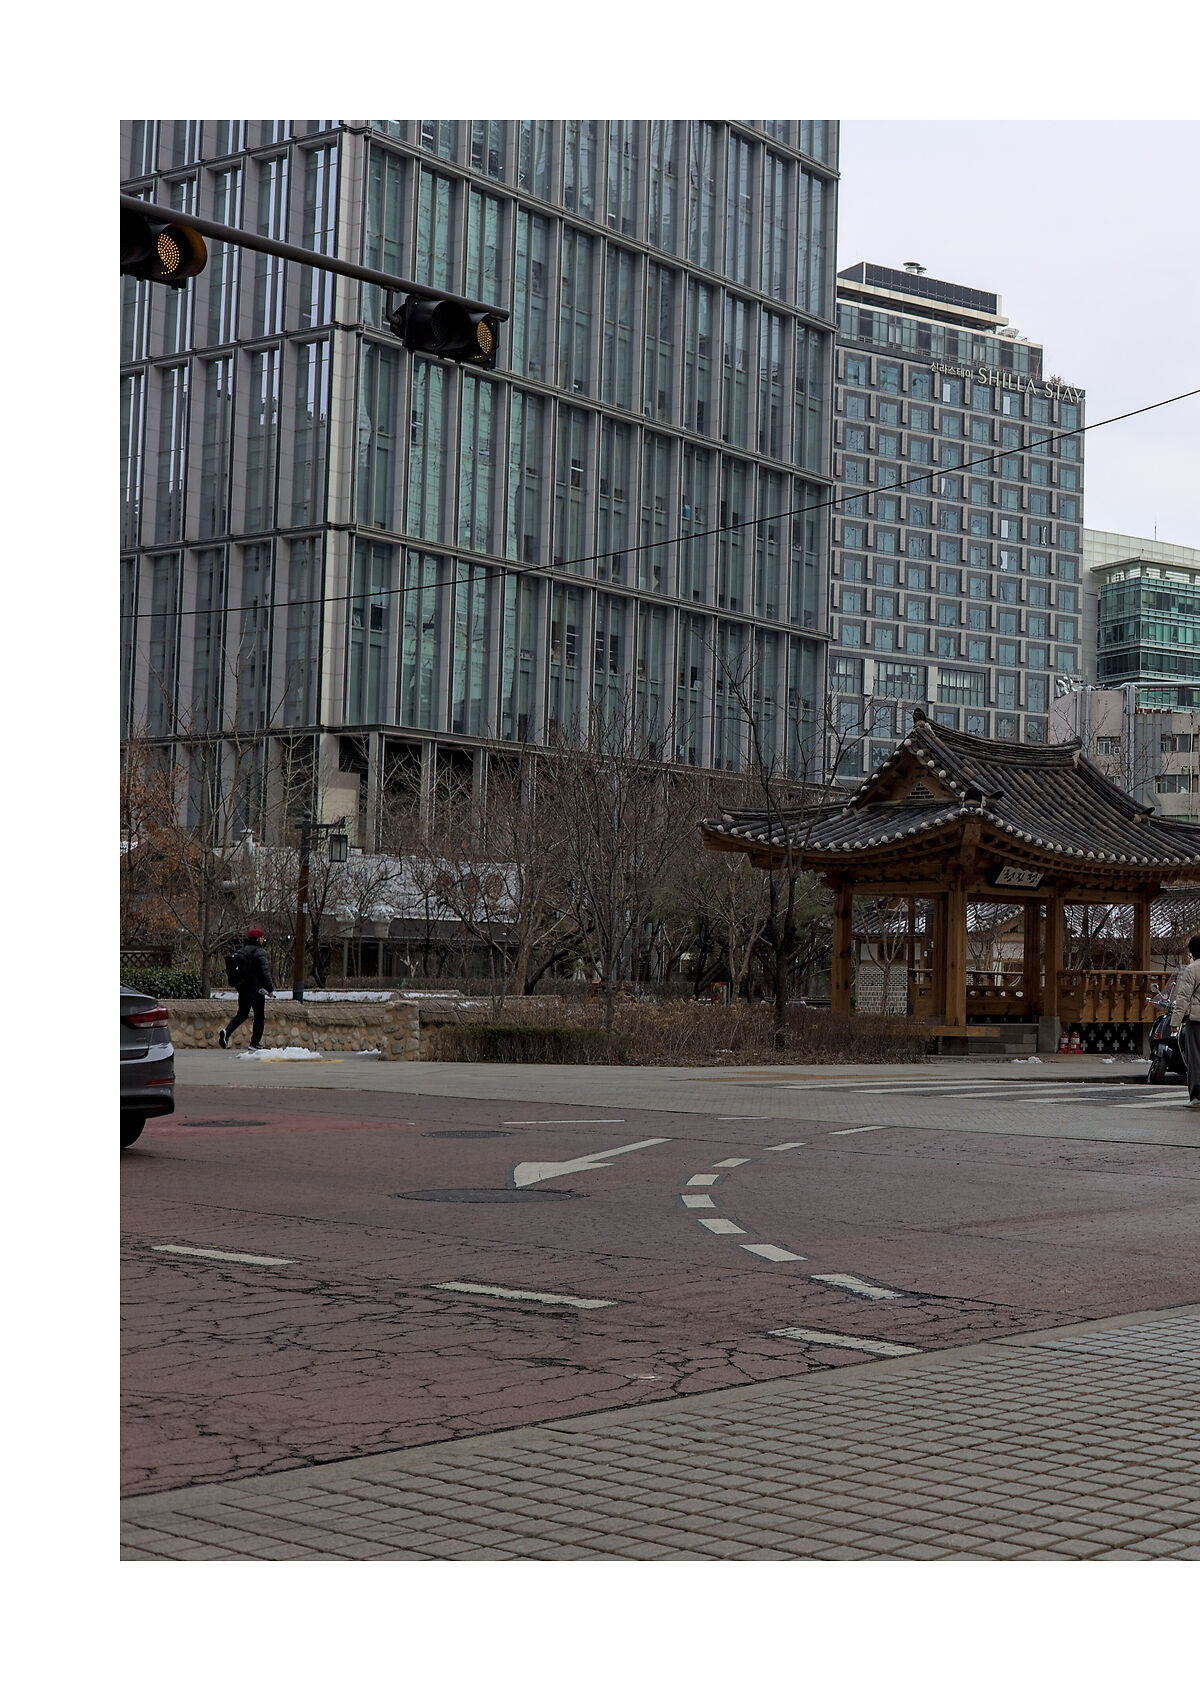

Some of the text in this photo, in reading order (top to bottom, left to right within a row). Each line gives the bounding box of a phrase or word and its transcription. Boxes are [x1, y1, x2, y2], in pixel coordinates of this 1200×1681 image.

[929, 362, 974, 379] 신라스테이
[977, 367, 1084, 404] SHILLA STAY
